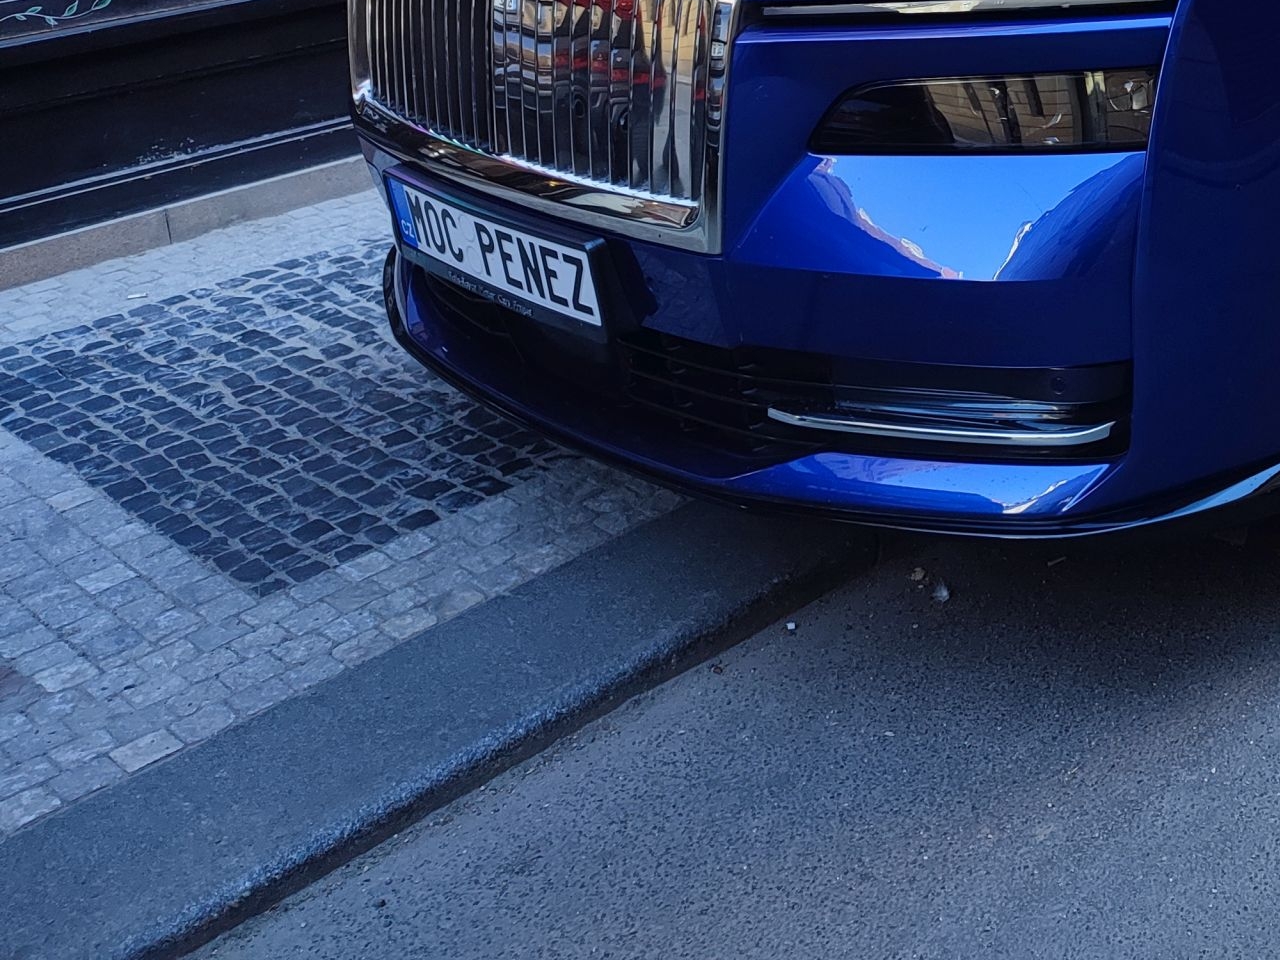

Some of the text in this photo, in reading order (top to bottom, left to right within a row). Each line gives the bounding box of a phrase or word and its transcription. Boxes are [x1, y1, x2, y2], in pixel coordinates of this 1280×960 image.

[401, 219, 415, 238] CZ
[405, 190, 464, 263] MOC
[474, 221, 594, 316] PENEZ
